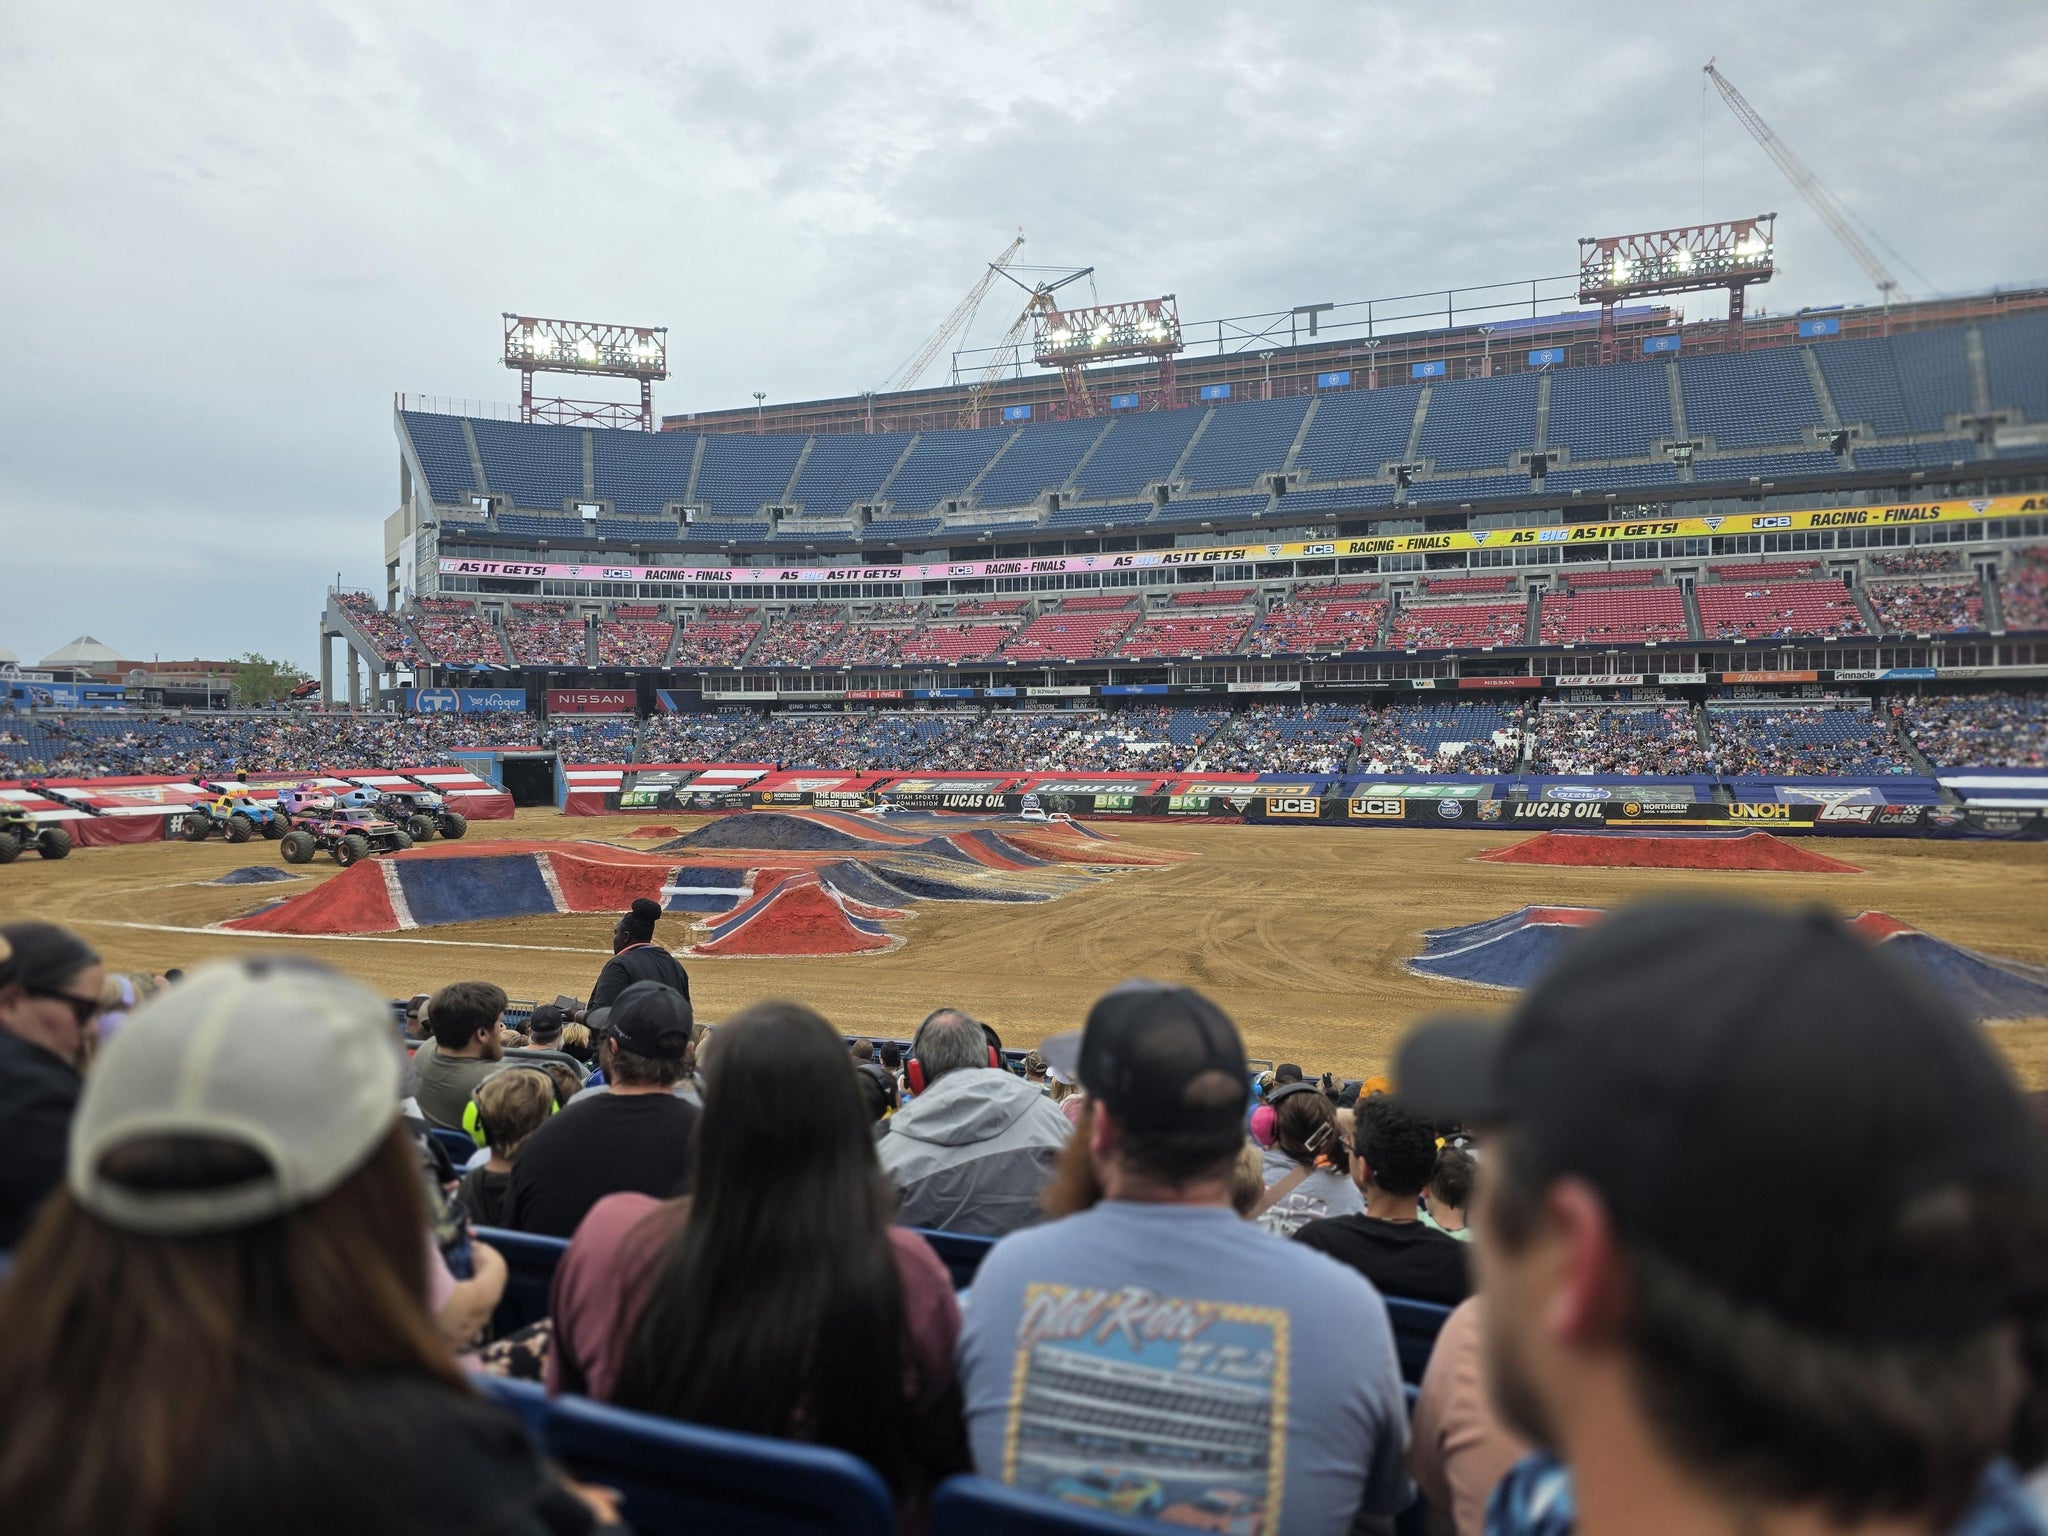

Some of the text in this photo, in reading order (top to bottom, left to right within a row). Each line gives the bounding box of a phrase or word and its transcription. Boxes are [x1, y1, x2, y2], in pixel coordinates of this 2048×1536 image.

[1752, 516, 1791, 528] JCB
[1810, 511, 1868, 526] RACING
[1884, 506, 1941, 522] FINALS
[1510, 523, 1679, 543] AS BIG AS IT GETS!
[1303, 544, 1334, 555] JCB
[1349, 540, 1394, 554] RACING
[1406, 536, 1450, 550] FINALS
[1113, 549, 1247, 567] AS BIG AS IT GETS!
[458, 562, 480, 572] AS
[482, 564, 500, 573] IT
[502, 565, 547, 576] GETS!
[949, 566, 973, 575] JCB
[985, 563, 1021, 574] RACING
[1031, 560, 1066, 572] FINALS
[603, 569, 632, 578] JCB
[645, 570, 685, 580] RACING
[695, 571, 733, 581] FINALS
[780, 569, 902, 580] AS BIG AS IT GETS!
[1836, 671, 1876, 680] Pinnacle
[485, 693, 520, 709] Kroger
[559, 694, 625, 704] NISSAN
[1037, 784, 1138, 793] LUCAS OIL
[622, 792, 658, 805] BKT
[815, 791, 864, 799] THE ORIGINAL
[942, 794, 984, 808] LUCAS
[1095, 795, 1134, 807] BKT
[814, 800, 861, 808] SUPER GLUE
[1169, 796, 1211, 808] BKT
[1270, 799, 1316, 813] JCB
[1353, 800, 1401, 814] JCB
[1515, 803, 1573, 818] LUCAS
[1729, 803, 1790, 818] UNOH
[1883, 805, 1904, 814] RC
[1880, 814, 1918, 824] CARS
[1017, 1287, 1107, 1345] Old
